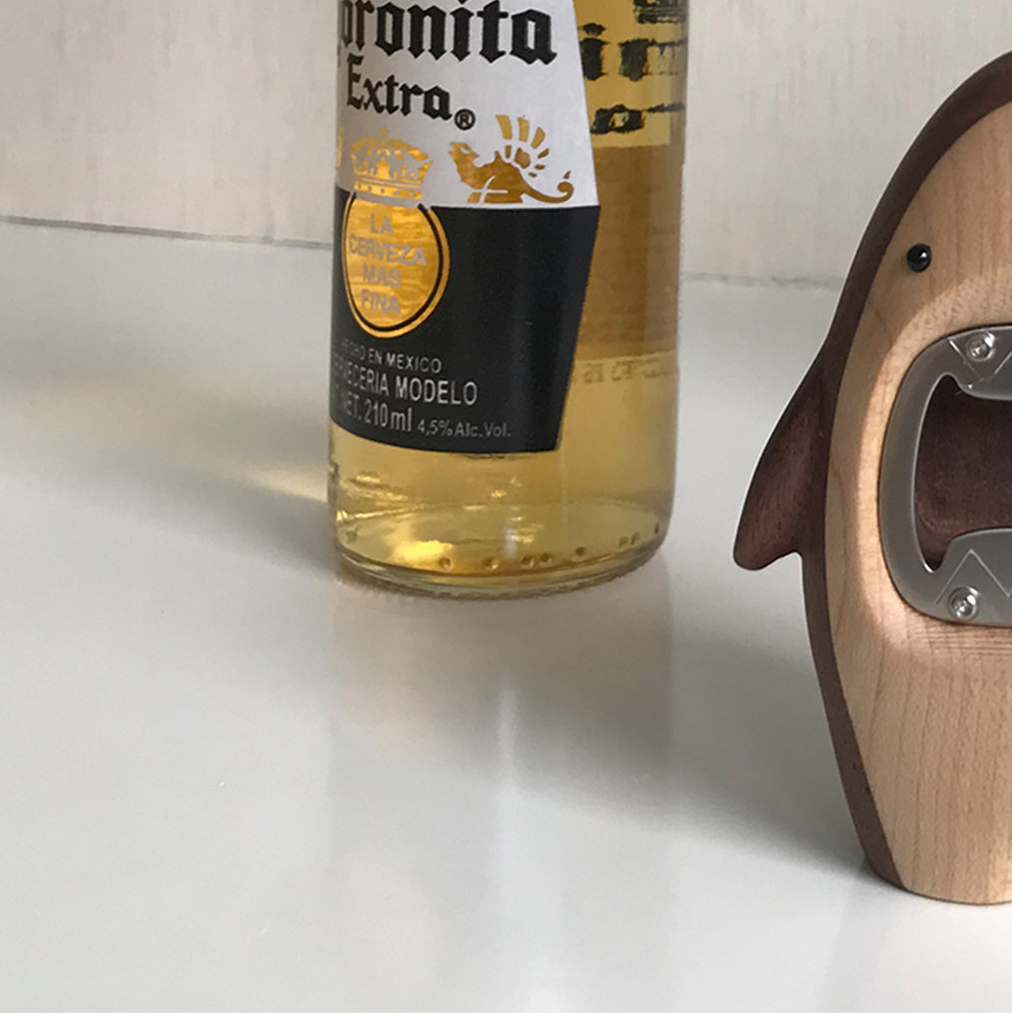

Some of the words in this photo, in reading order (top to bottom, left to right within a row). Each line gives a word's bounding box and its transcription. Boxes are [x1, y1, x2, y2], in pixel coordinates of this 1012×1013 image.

[369, 213, 394, 236] LA
[349, 234, 428, 267] CERVEZA
[360, 288, 401, 314] FINA
[369, 347, 383, 365] EN
[386, 352, 443, 374] MEXICO
[395, 374, 478, 406] MODELO
